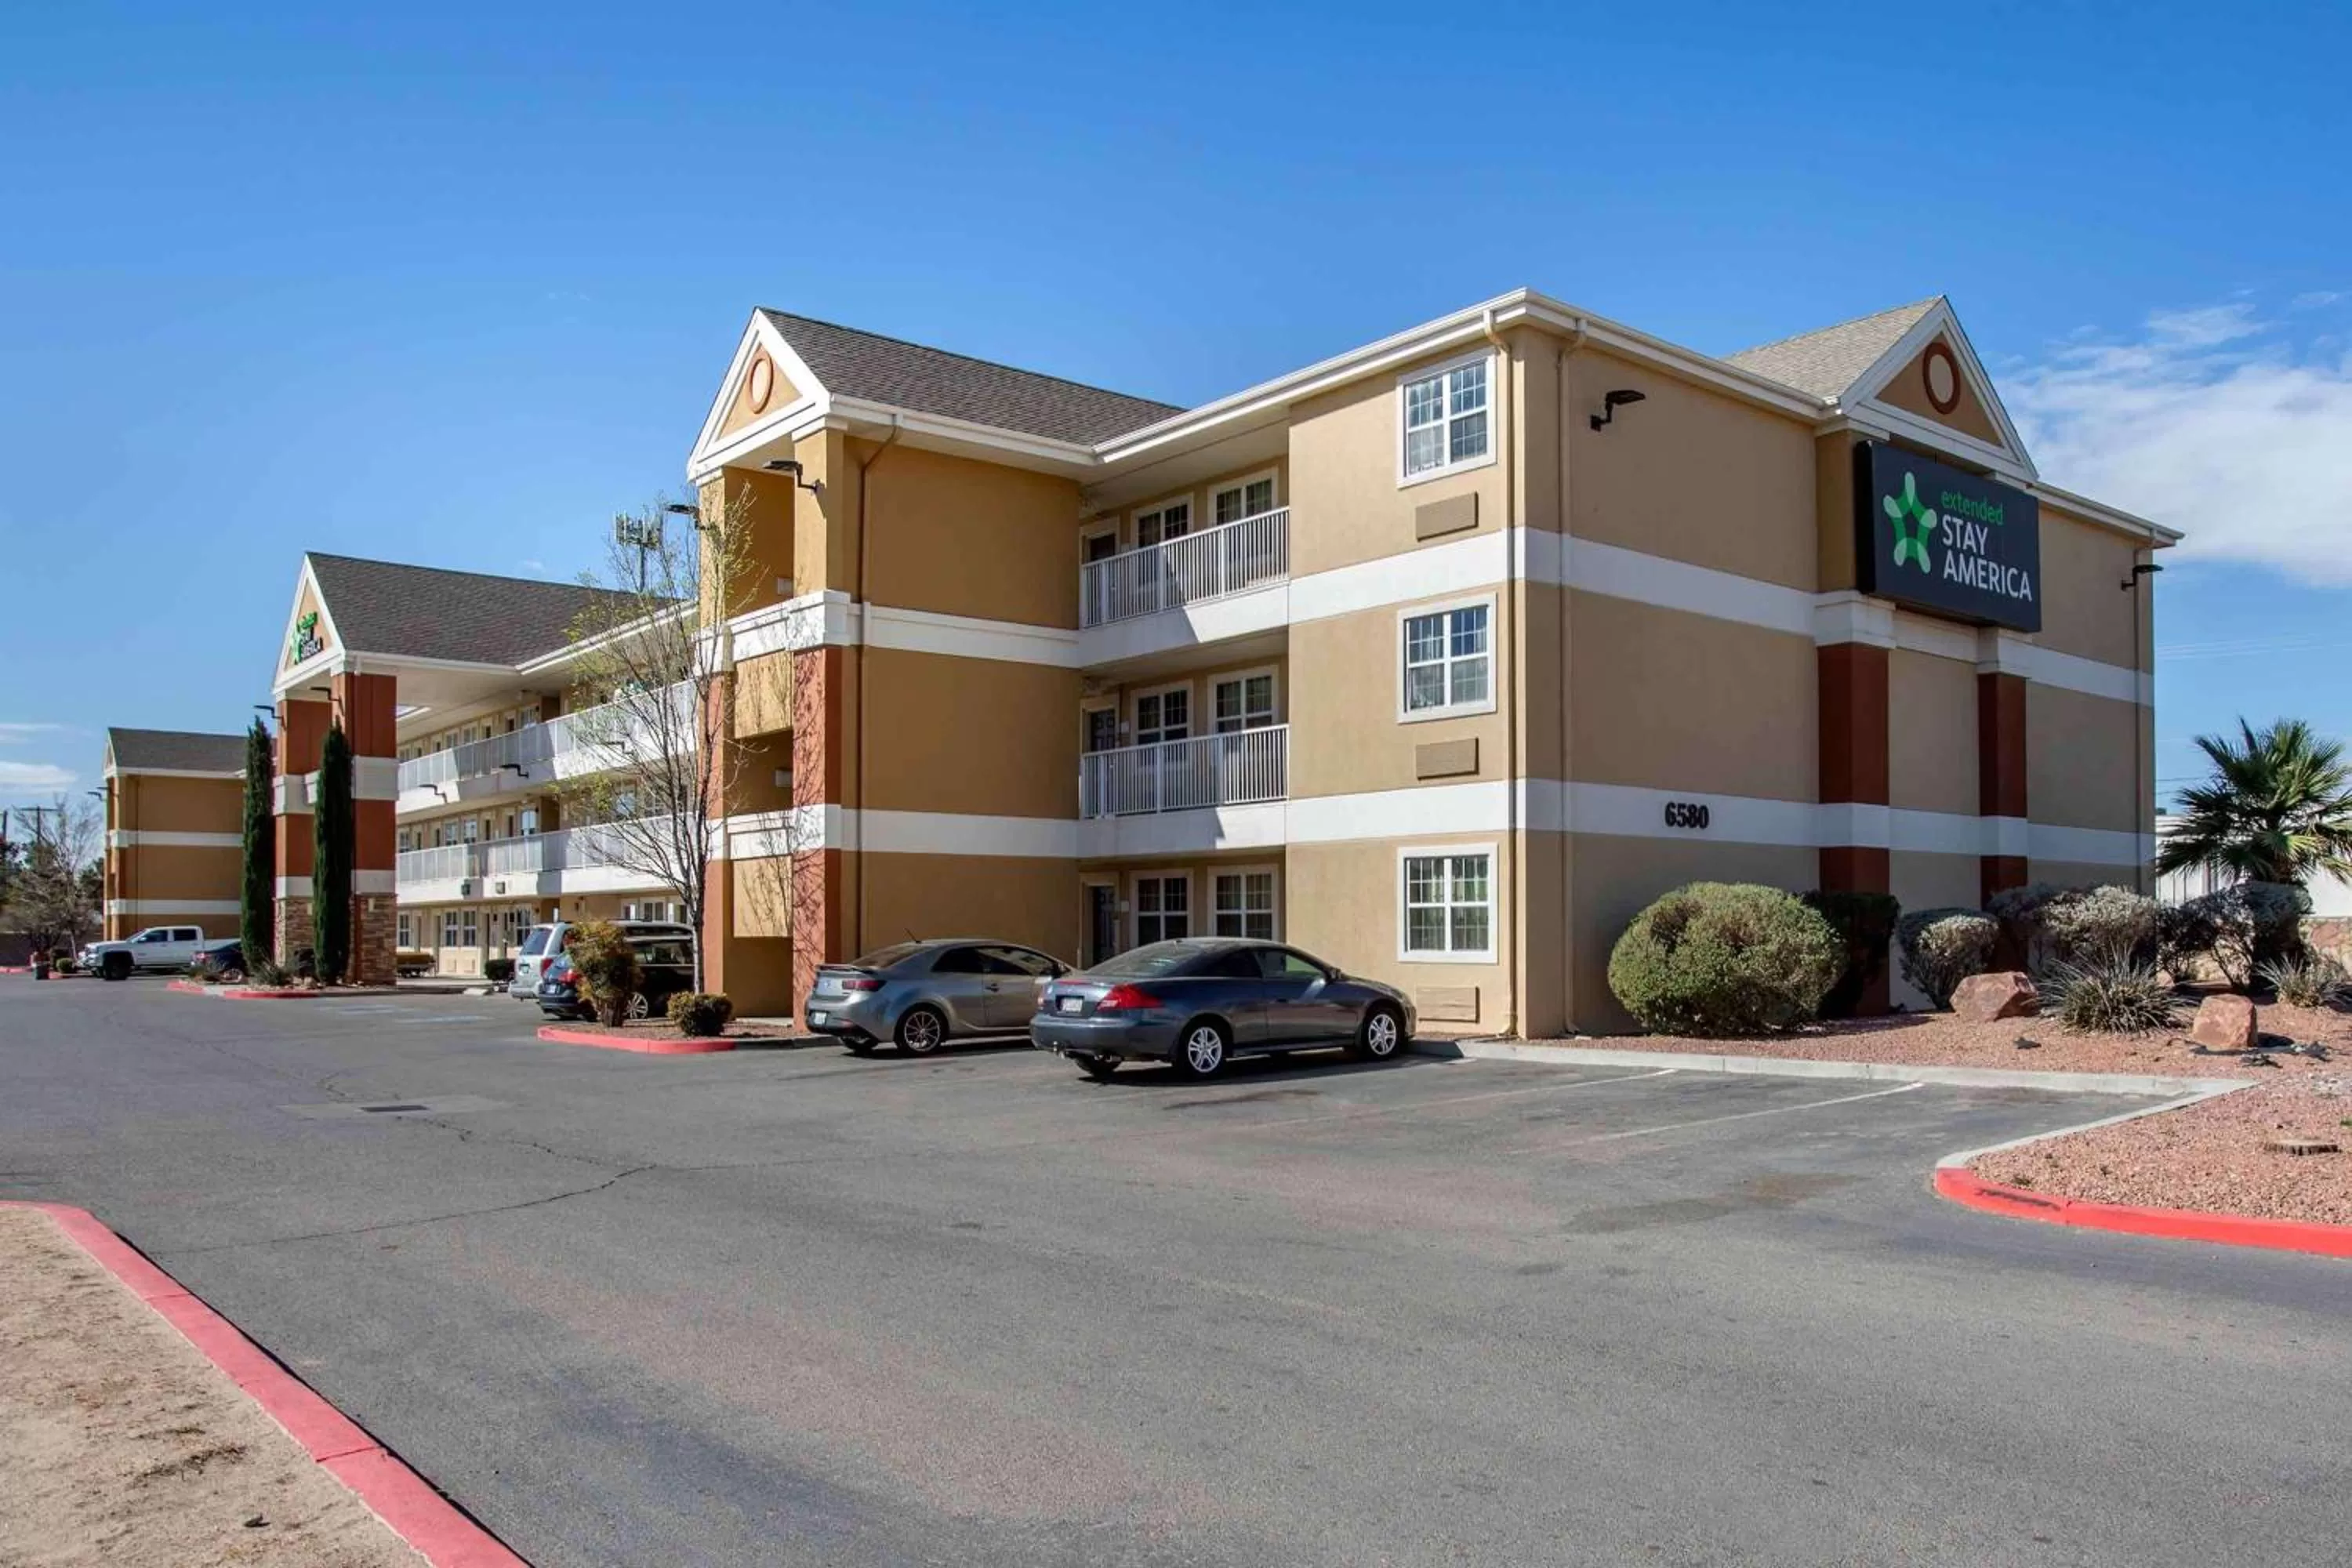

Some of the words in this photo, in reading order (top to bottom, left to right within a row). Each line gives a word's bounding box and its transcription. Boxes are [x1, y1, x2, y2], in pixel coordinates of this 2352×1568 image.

[1941, 490, 2003, 526] extended
[1942, 514, 1988, 556] STAY
[1944, 549, 2033, 602] AMERICA
[1664, 801, 1709, 829] 6580
